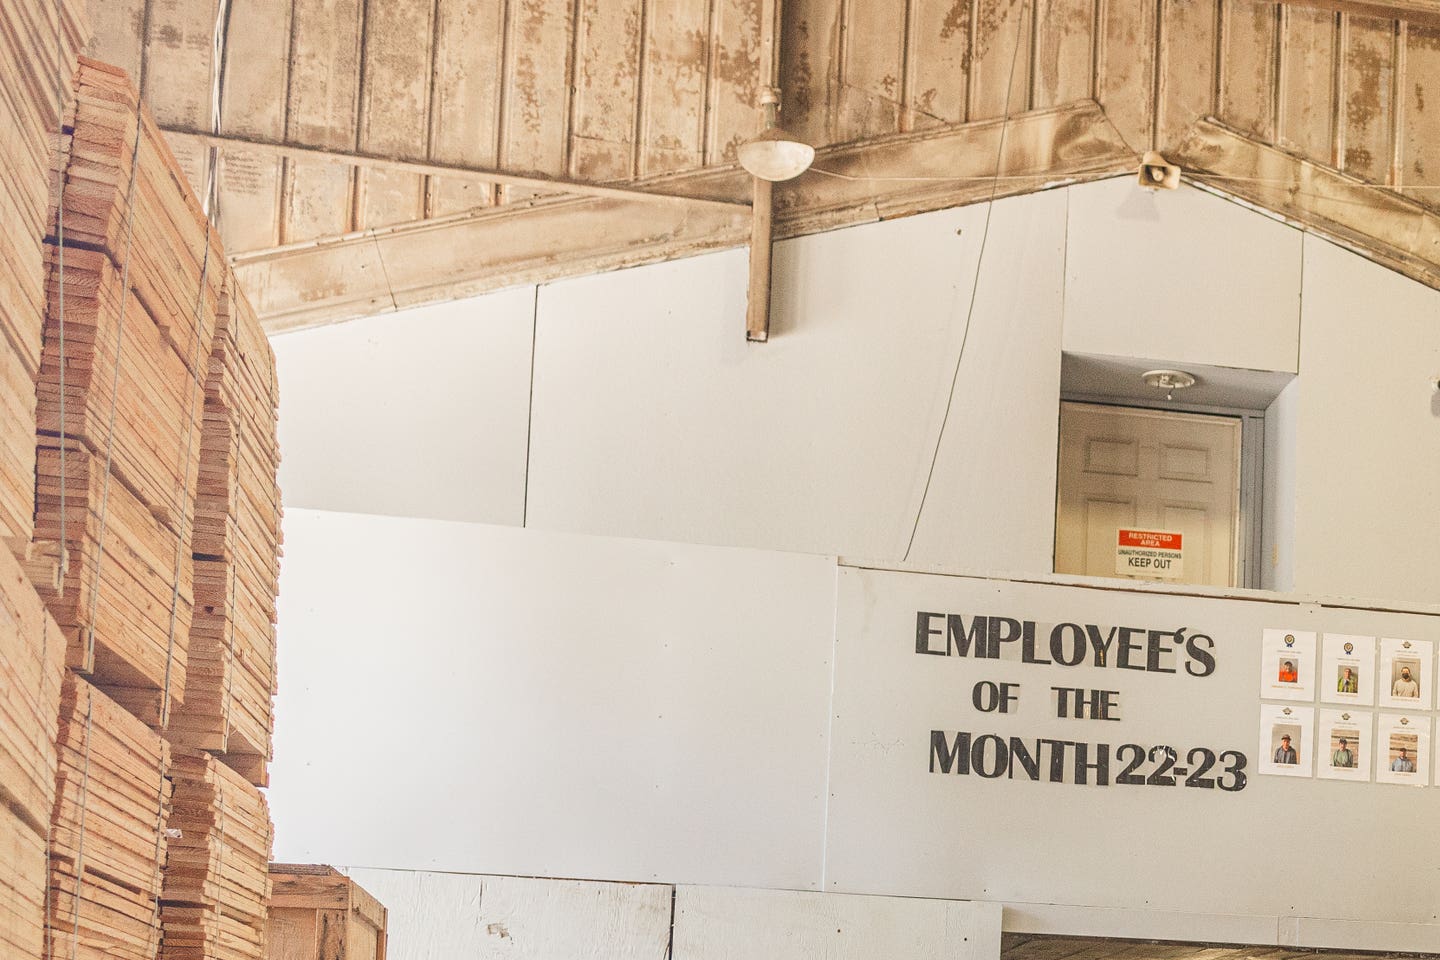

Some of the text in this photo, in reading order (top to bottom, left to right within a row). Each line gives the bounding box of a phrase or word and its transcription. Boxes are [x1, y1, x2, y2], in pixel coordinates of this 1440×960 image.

[1128, 532, 1173, 542] RESTRICTED
[1118, 549, 1157, 558] UNAUTHORIZED
[1128, 557, 1172, 569] KEEP OUT
[972, 680, 1121, 722] OF THE
